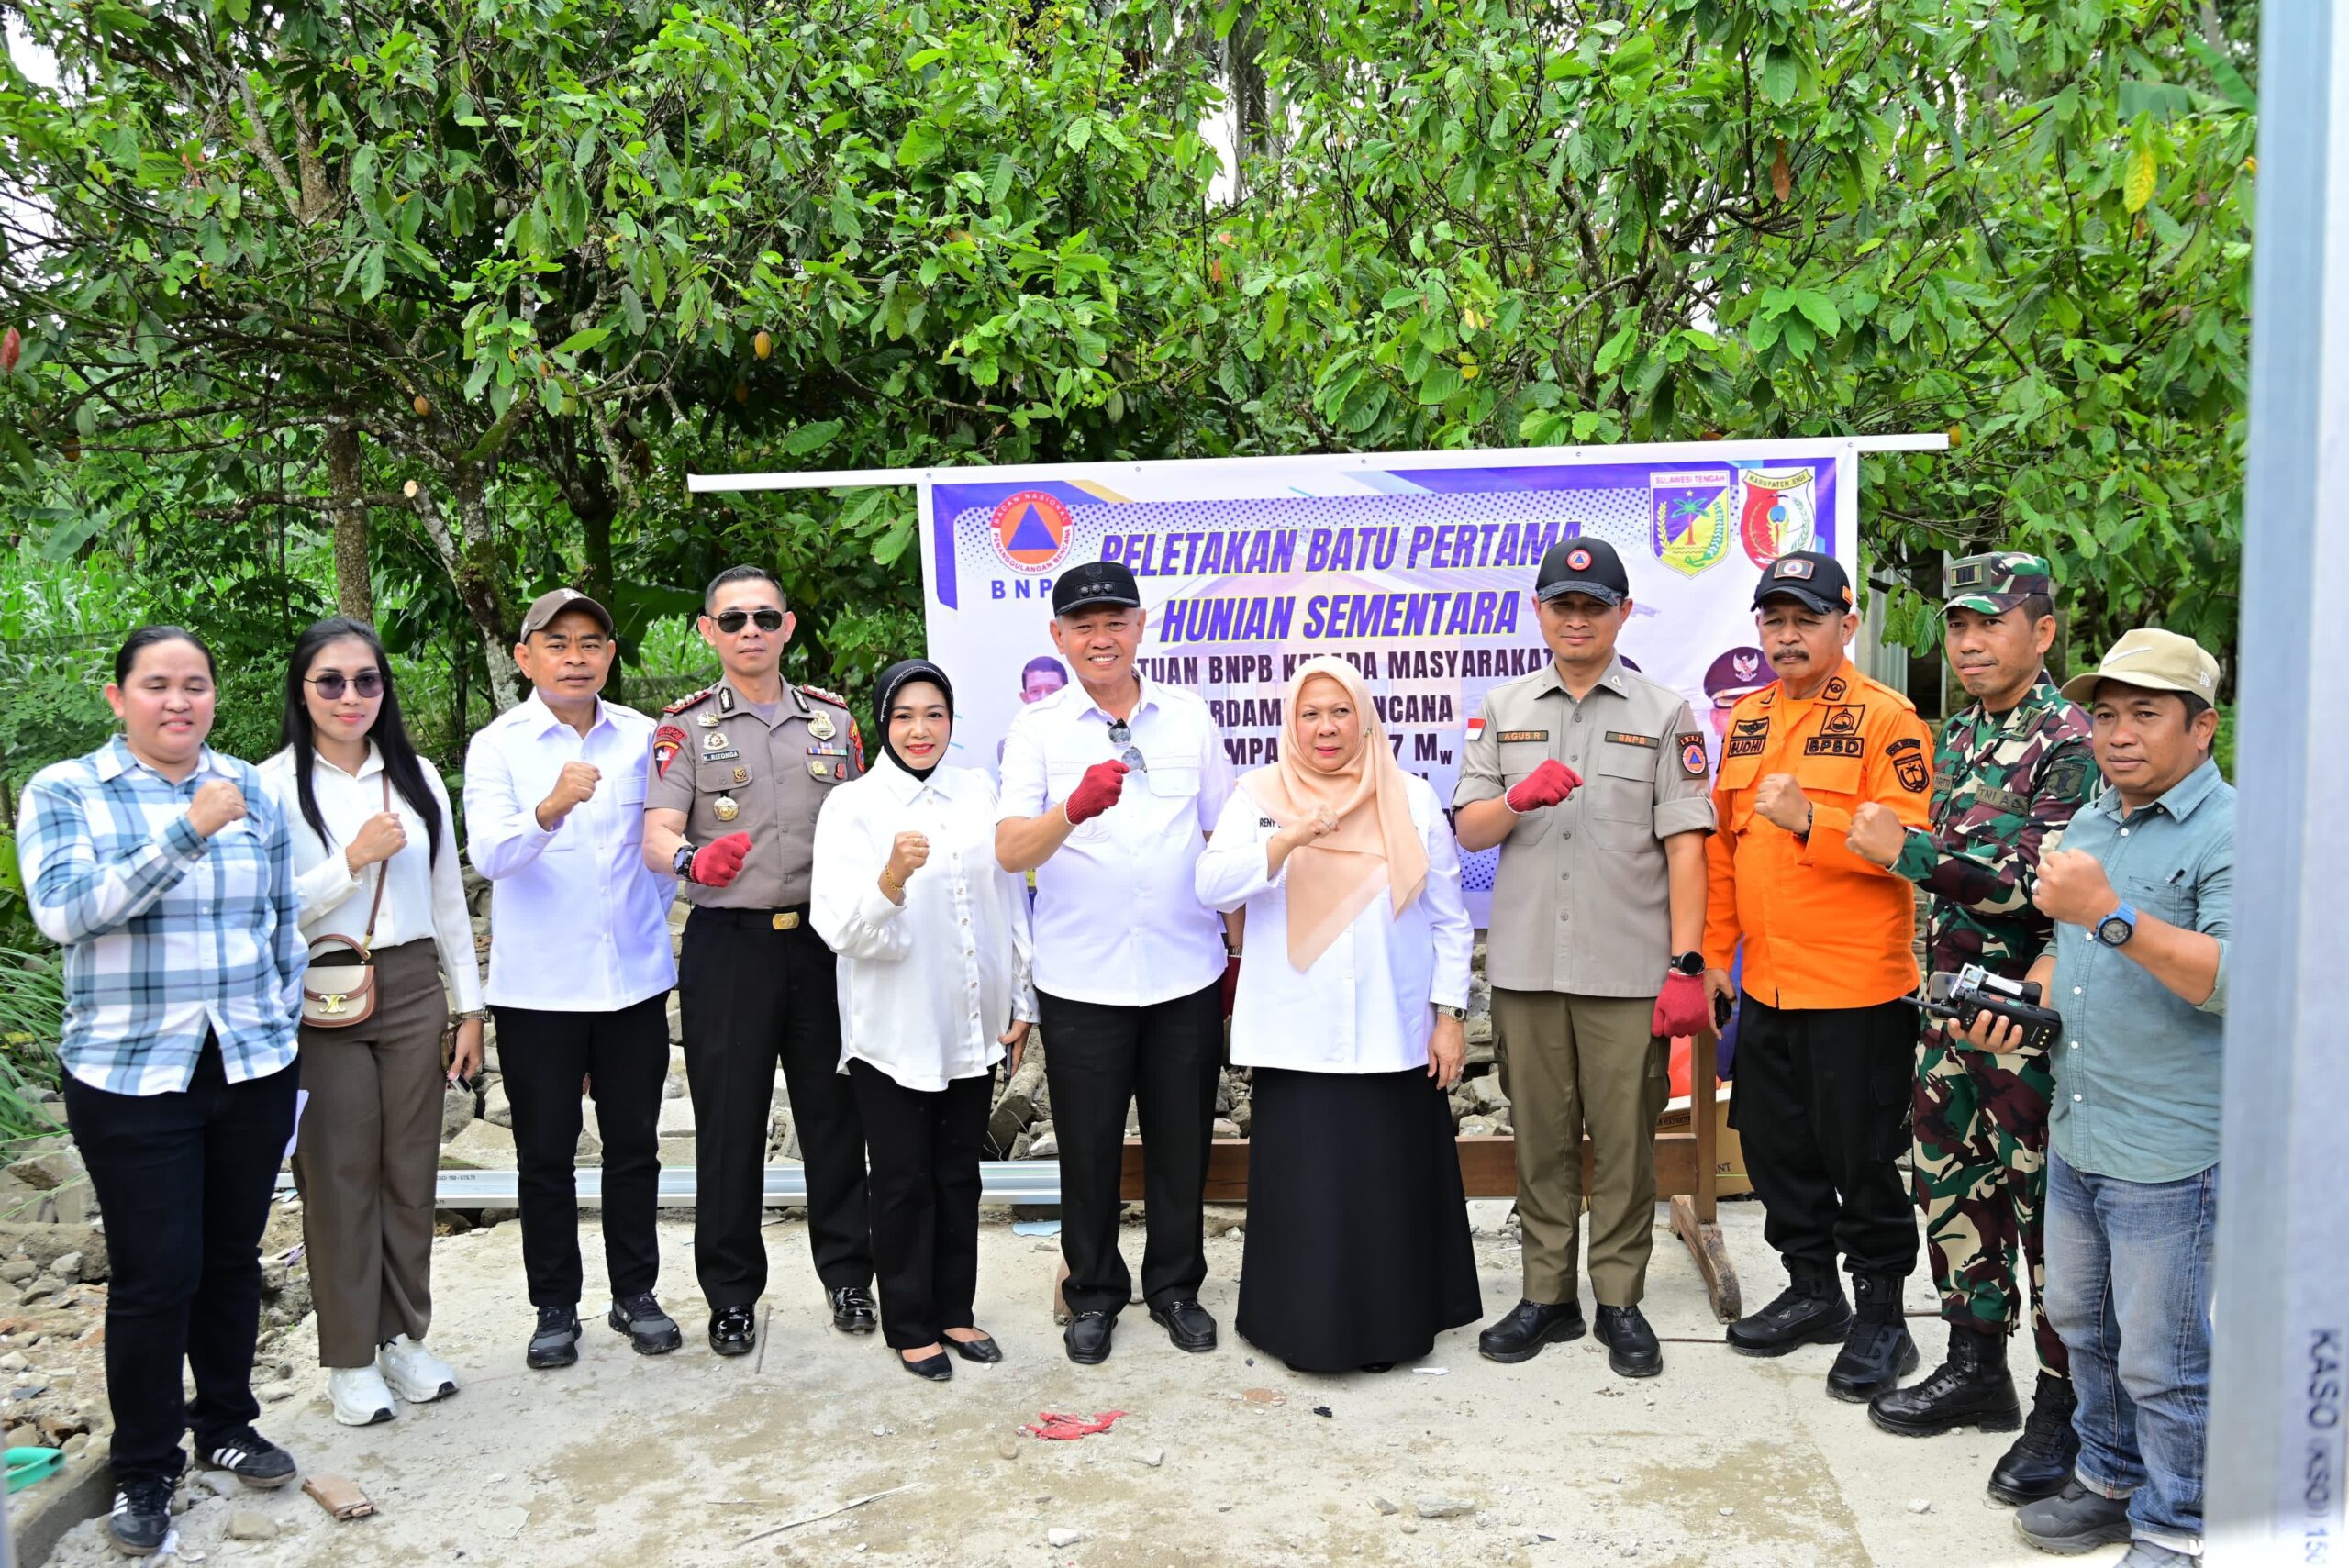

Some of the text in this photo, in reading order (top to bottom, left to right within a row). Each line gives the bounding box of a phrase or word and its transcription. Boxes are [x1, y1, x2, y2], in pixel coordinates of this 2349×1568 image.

[1694, 474, 1725, 484] TENGAH
[1748, 474, 1806, 488] KABUPATEN SIGI
[994, 493, 1068, 525] BADAN NASIONAL
[993, 528, 1071, 573] PENANGGULANGAN BENCANA
[1100, 529, 1298, 577] PELETAKAN
[1305, 526, 1400, 573] BATU
[1159, 590, 1520, 643] HUNIAN SEMENTARA
[1134, 656, 1198, 685] TUAN
[1208, 654, 1273, 684] BNPB
[1504, 731, 1542, 741] AGUS R
[1618, 733, 1645, 745] BNPB
[1809, 740, 1859, 754] BPBD
[1977, 789, 1997, 801] TNI
[2309, 1328, 2341, 1430] KASO
